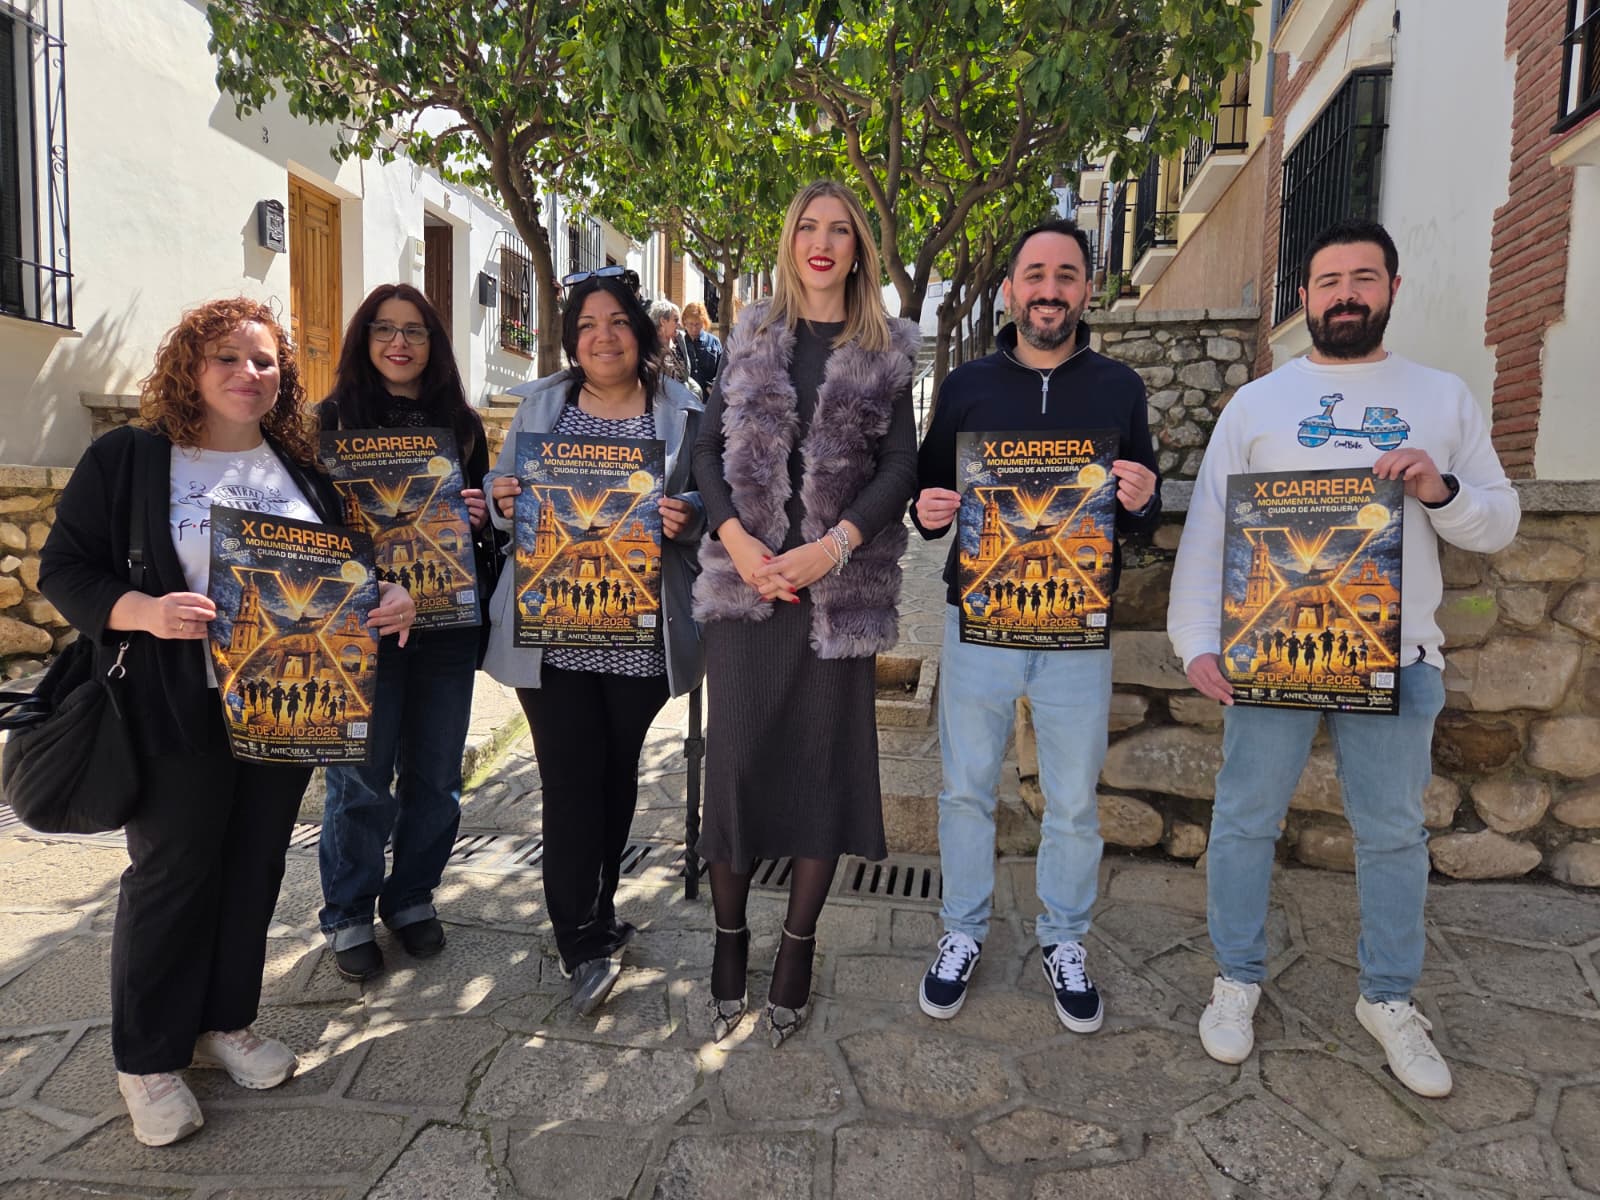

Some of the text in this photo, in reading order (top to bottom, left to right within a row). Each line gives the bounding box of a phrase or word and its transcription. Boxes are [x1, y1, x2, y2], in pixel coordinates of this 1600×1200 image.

[336, 436, 437, 453] X CARRERA
[984, 440, 1094, 457] X CARRERA
[341, 450, 435, 460] MONUMENTAL NOCTURNA
[541, 442, 643, 462] X CARRERA
[544, 459, 596, 468] MONUMENTAL
[987, 457, 1043, 466] MONUMENTAL
[1254, 477, 1375, 498] X CARRERA
[1258, 496, 1370, 506] MONUMENTAL NOCTURNA
[242, 520, 352, 552] X CARRERA
[246, 538, 350, 559] MONUMENTAL NOCTURNA
[422, 597, 449, 606] 2026
[546, 616, 552, 624] 5
[556, 616, 568, 624] DE
[571, 616, 600, 626] JUNIO
[604, 617, 630, 626] 2026
[991, 617, 997, 625] 5
[999, 618, 1013, 626] DE
[1015, 618, 1048, 626] JUNIO
[1050, 618, 1078, 626] 2026
[1257, 672, 1264, 682] 5
[1268, 673, 1283, 682] DE
[1286, 673, 1323, 683] JUNIO
[1326, 675, 1360, 685] 2026
[249, 725, 255, 734] 5
[257, 726, 270, 736] DE
[272, 727, 304, 736] JUNIO
[308, 727, 338, 736] 2026
